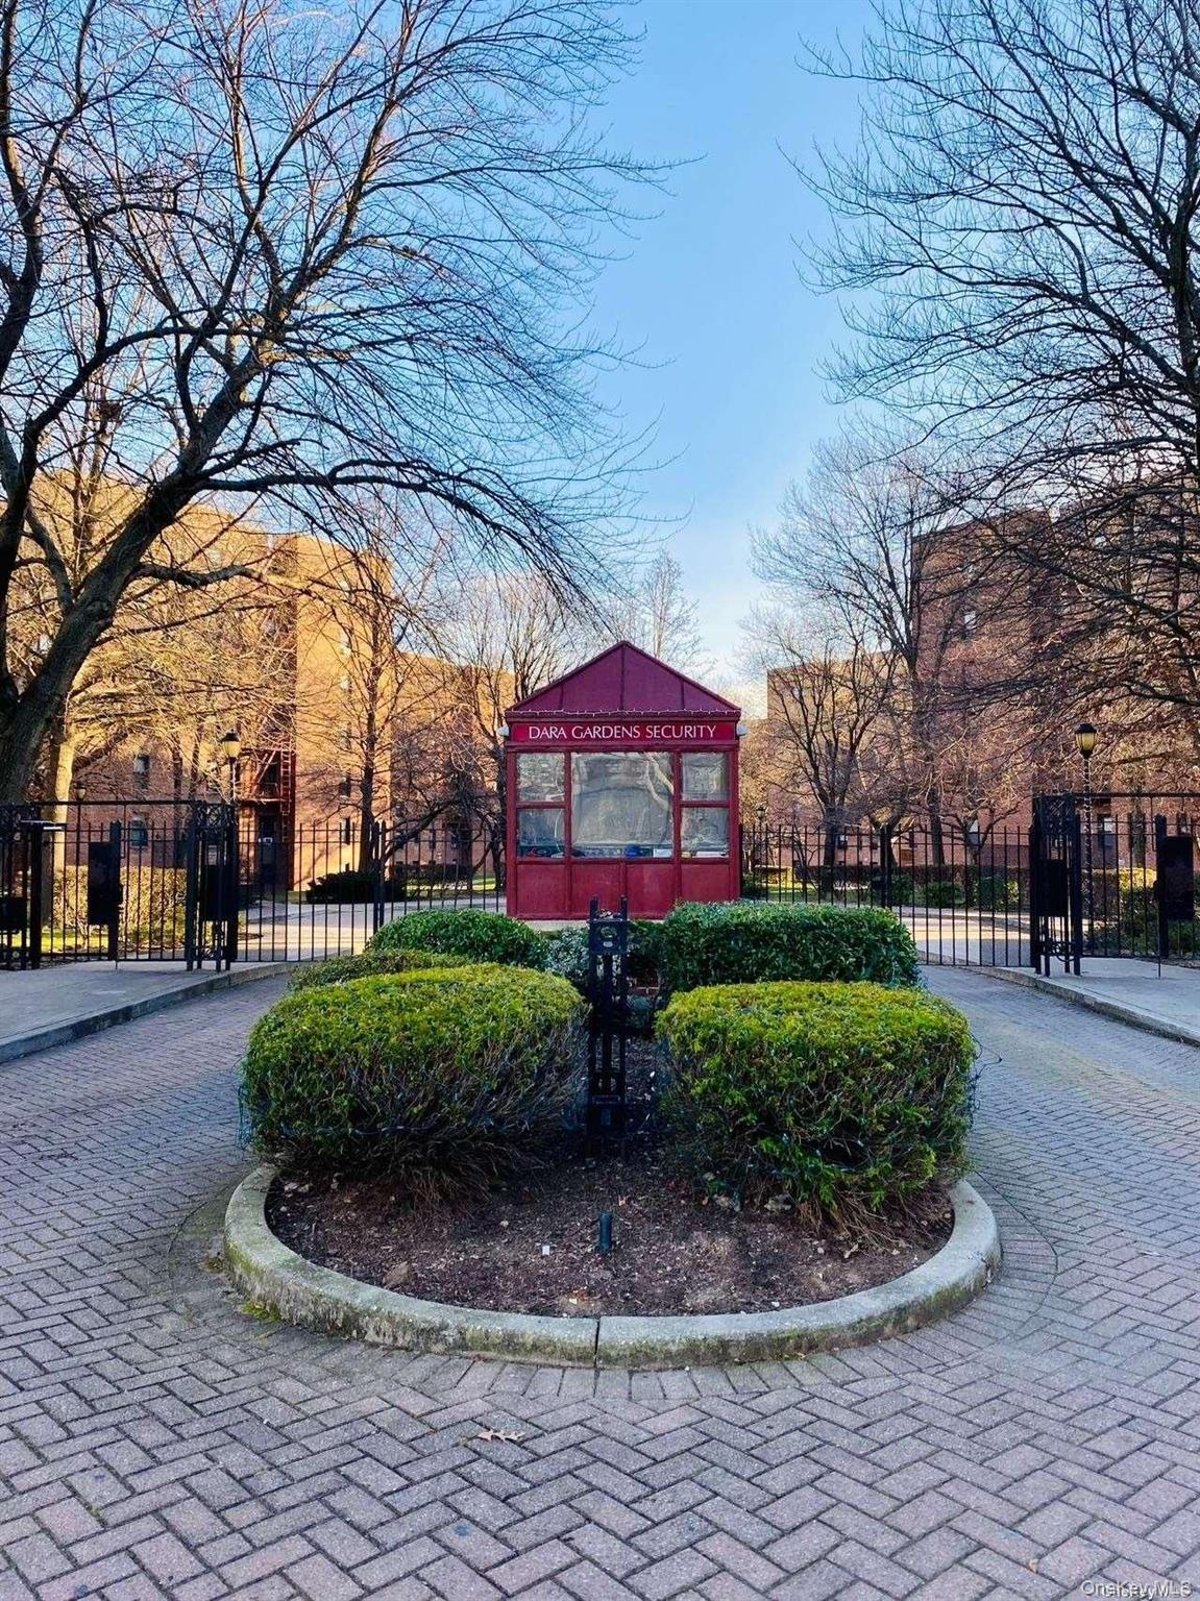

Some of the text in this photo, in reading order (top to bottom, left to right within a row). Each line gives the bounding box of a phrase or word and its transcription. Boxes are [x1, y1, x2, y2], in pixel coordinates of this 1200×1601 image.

[528, 725, 717, 739] DARA GARDENS SECURITY
